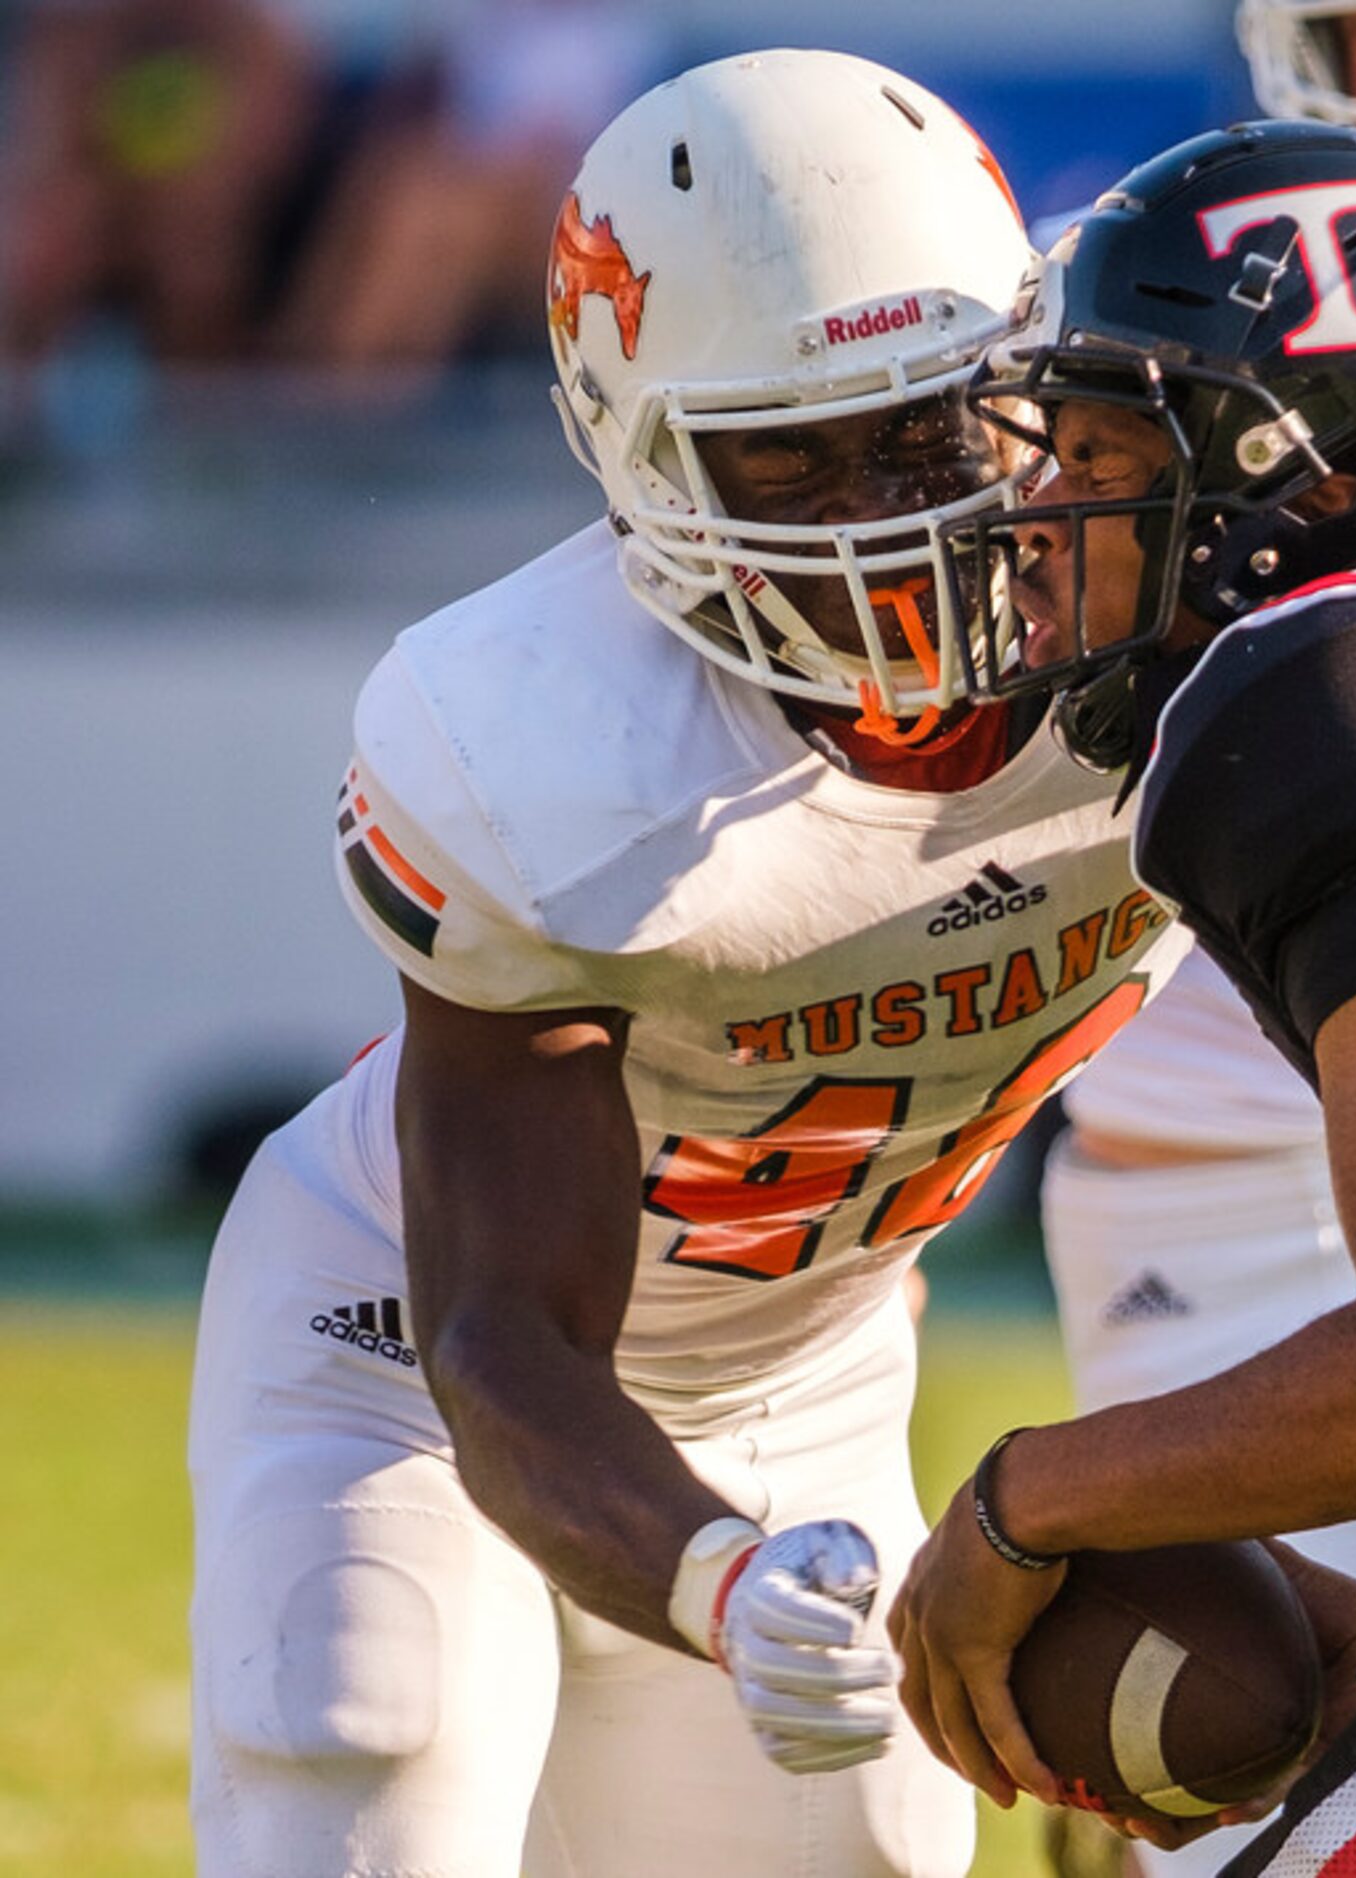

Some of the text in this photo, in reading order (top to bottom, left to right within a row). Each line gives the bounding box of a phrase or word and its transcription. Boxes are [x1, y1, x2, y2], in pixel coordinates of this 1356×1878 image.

[823, 296, 923, 345] Riddell
[927, 884, 1048, 936] adidas
[309, 1314, 418, 1368] adidas
